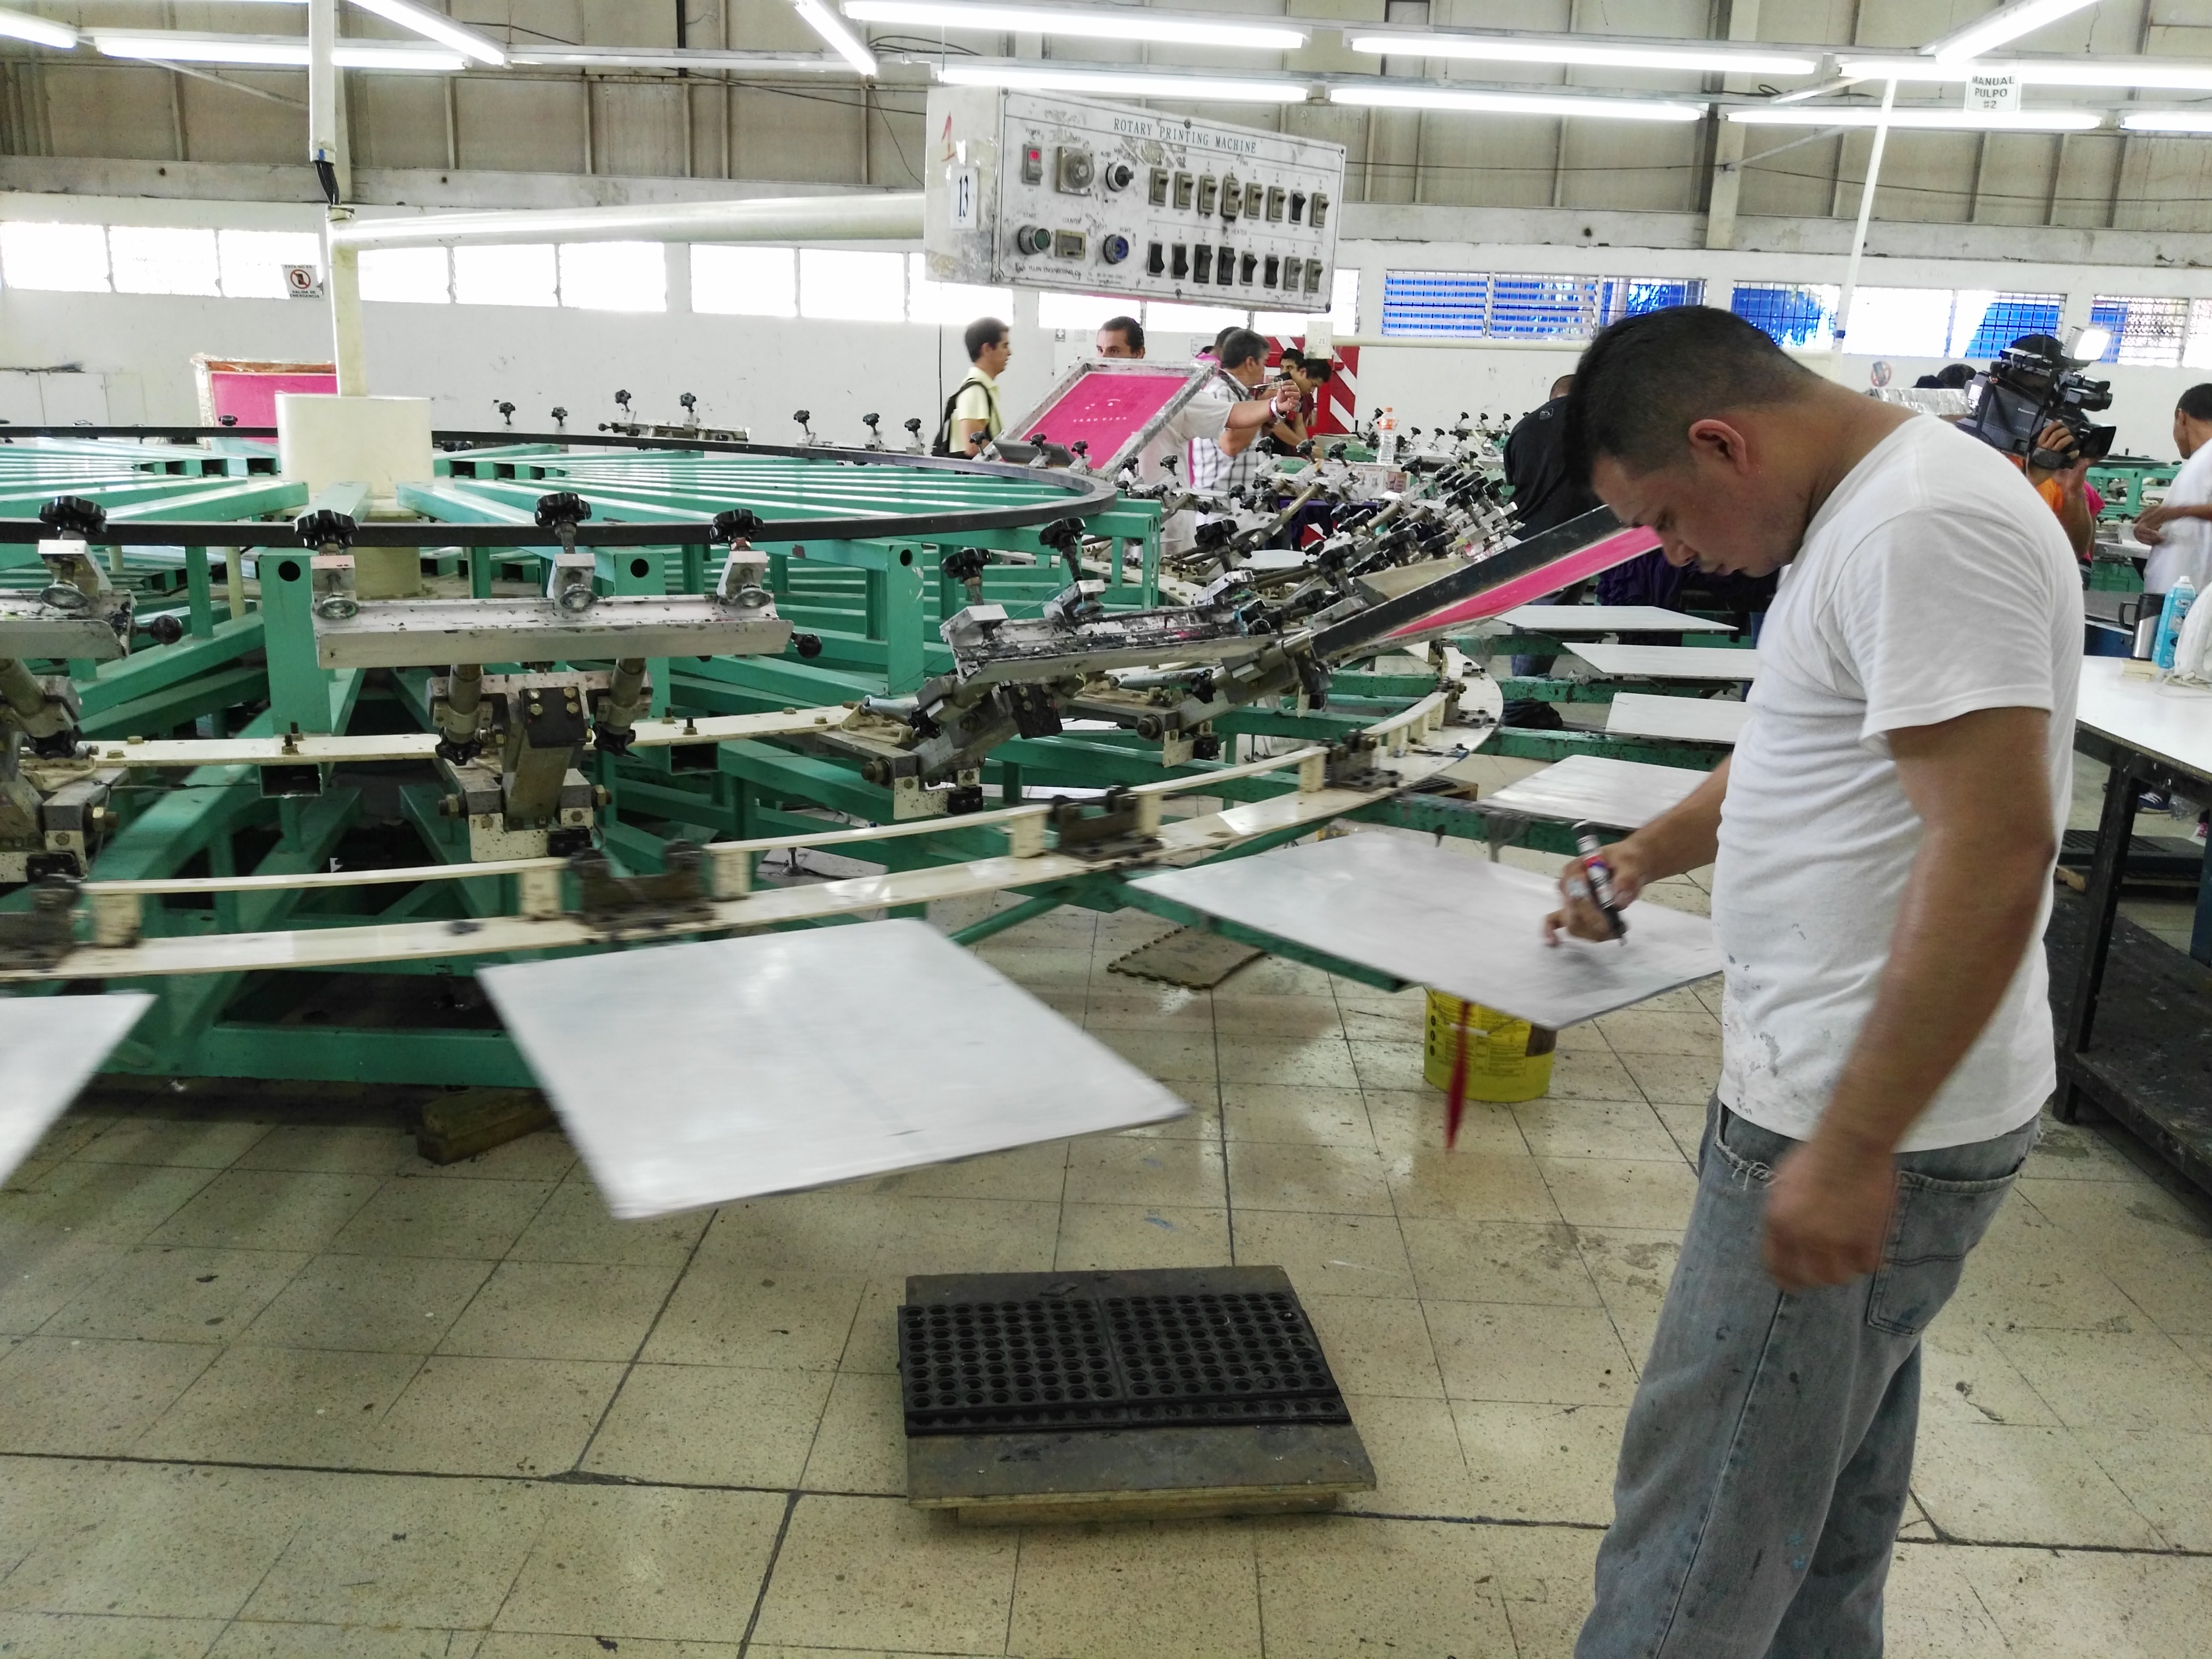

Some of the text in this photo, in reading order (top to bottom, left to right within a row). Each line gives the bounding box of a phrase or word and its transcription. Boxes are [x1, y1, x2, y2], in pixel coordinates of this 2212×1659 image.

[1972, 75, 2015, 86] MANUAL
[1975, 88, 2007, 98] PULPO
[1983, 100, 1996, 109] #2
[1114, 118, 1256, 154] ROTARY PRINTING MACHINE
[959, 174, 968, 218] 13
